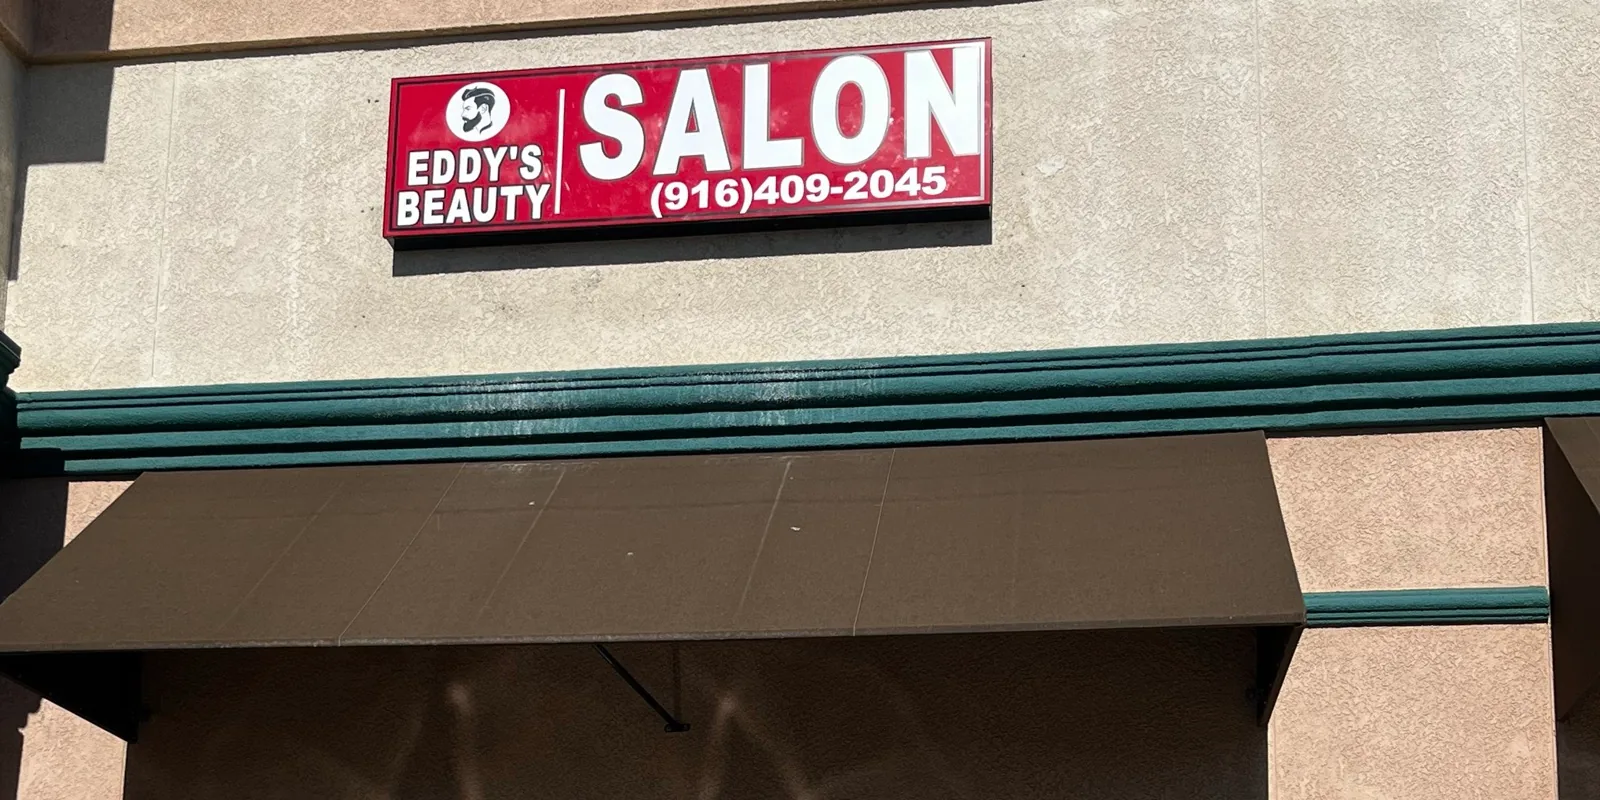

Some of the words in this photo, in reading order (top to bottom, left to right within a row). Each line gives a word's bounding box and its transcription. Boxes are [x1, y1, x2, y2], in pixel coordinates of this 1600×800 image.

[579, 46, 981, 181] SALON
[407, 144, 543, 186] EDDY'S
[397, 183, 551, 227] BEAUTY
[650, 165, 947, 219] (916)409-2045
